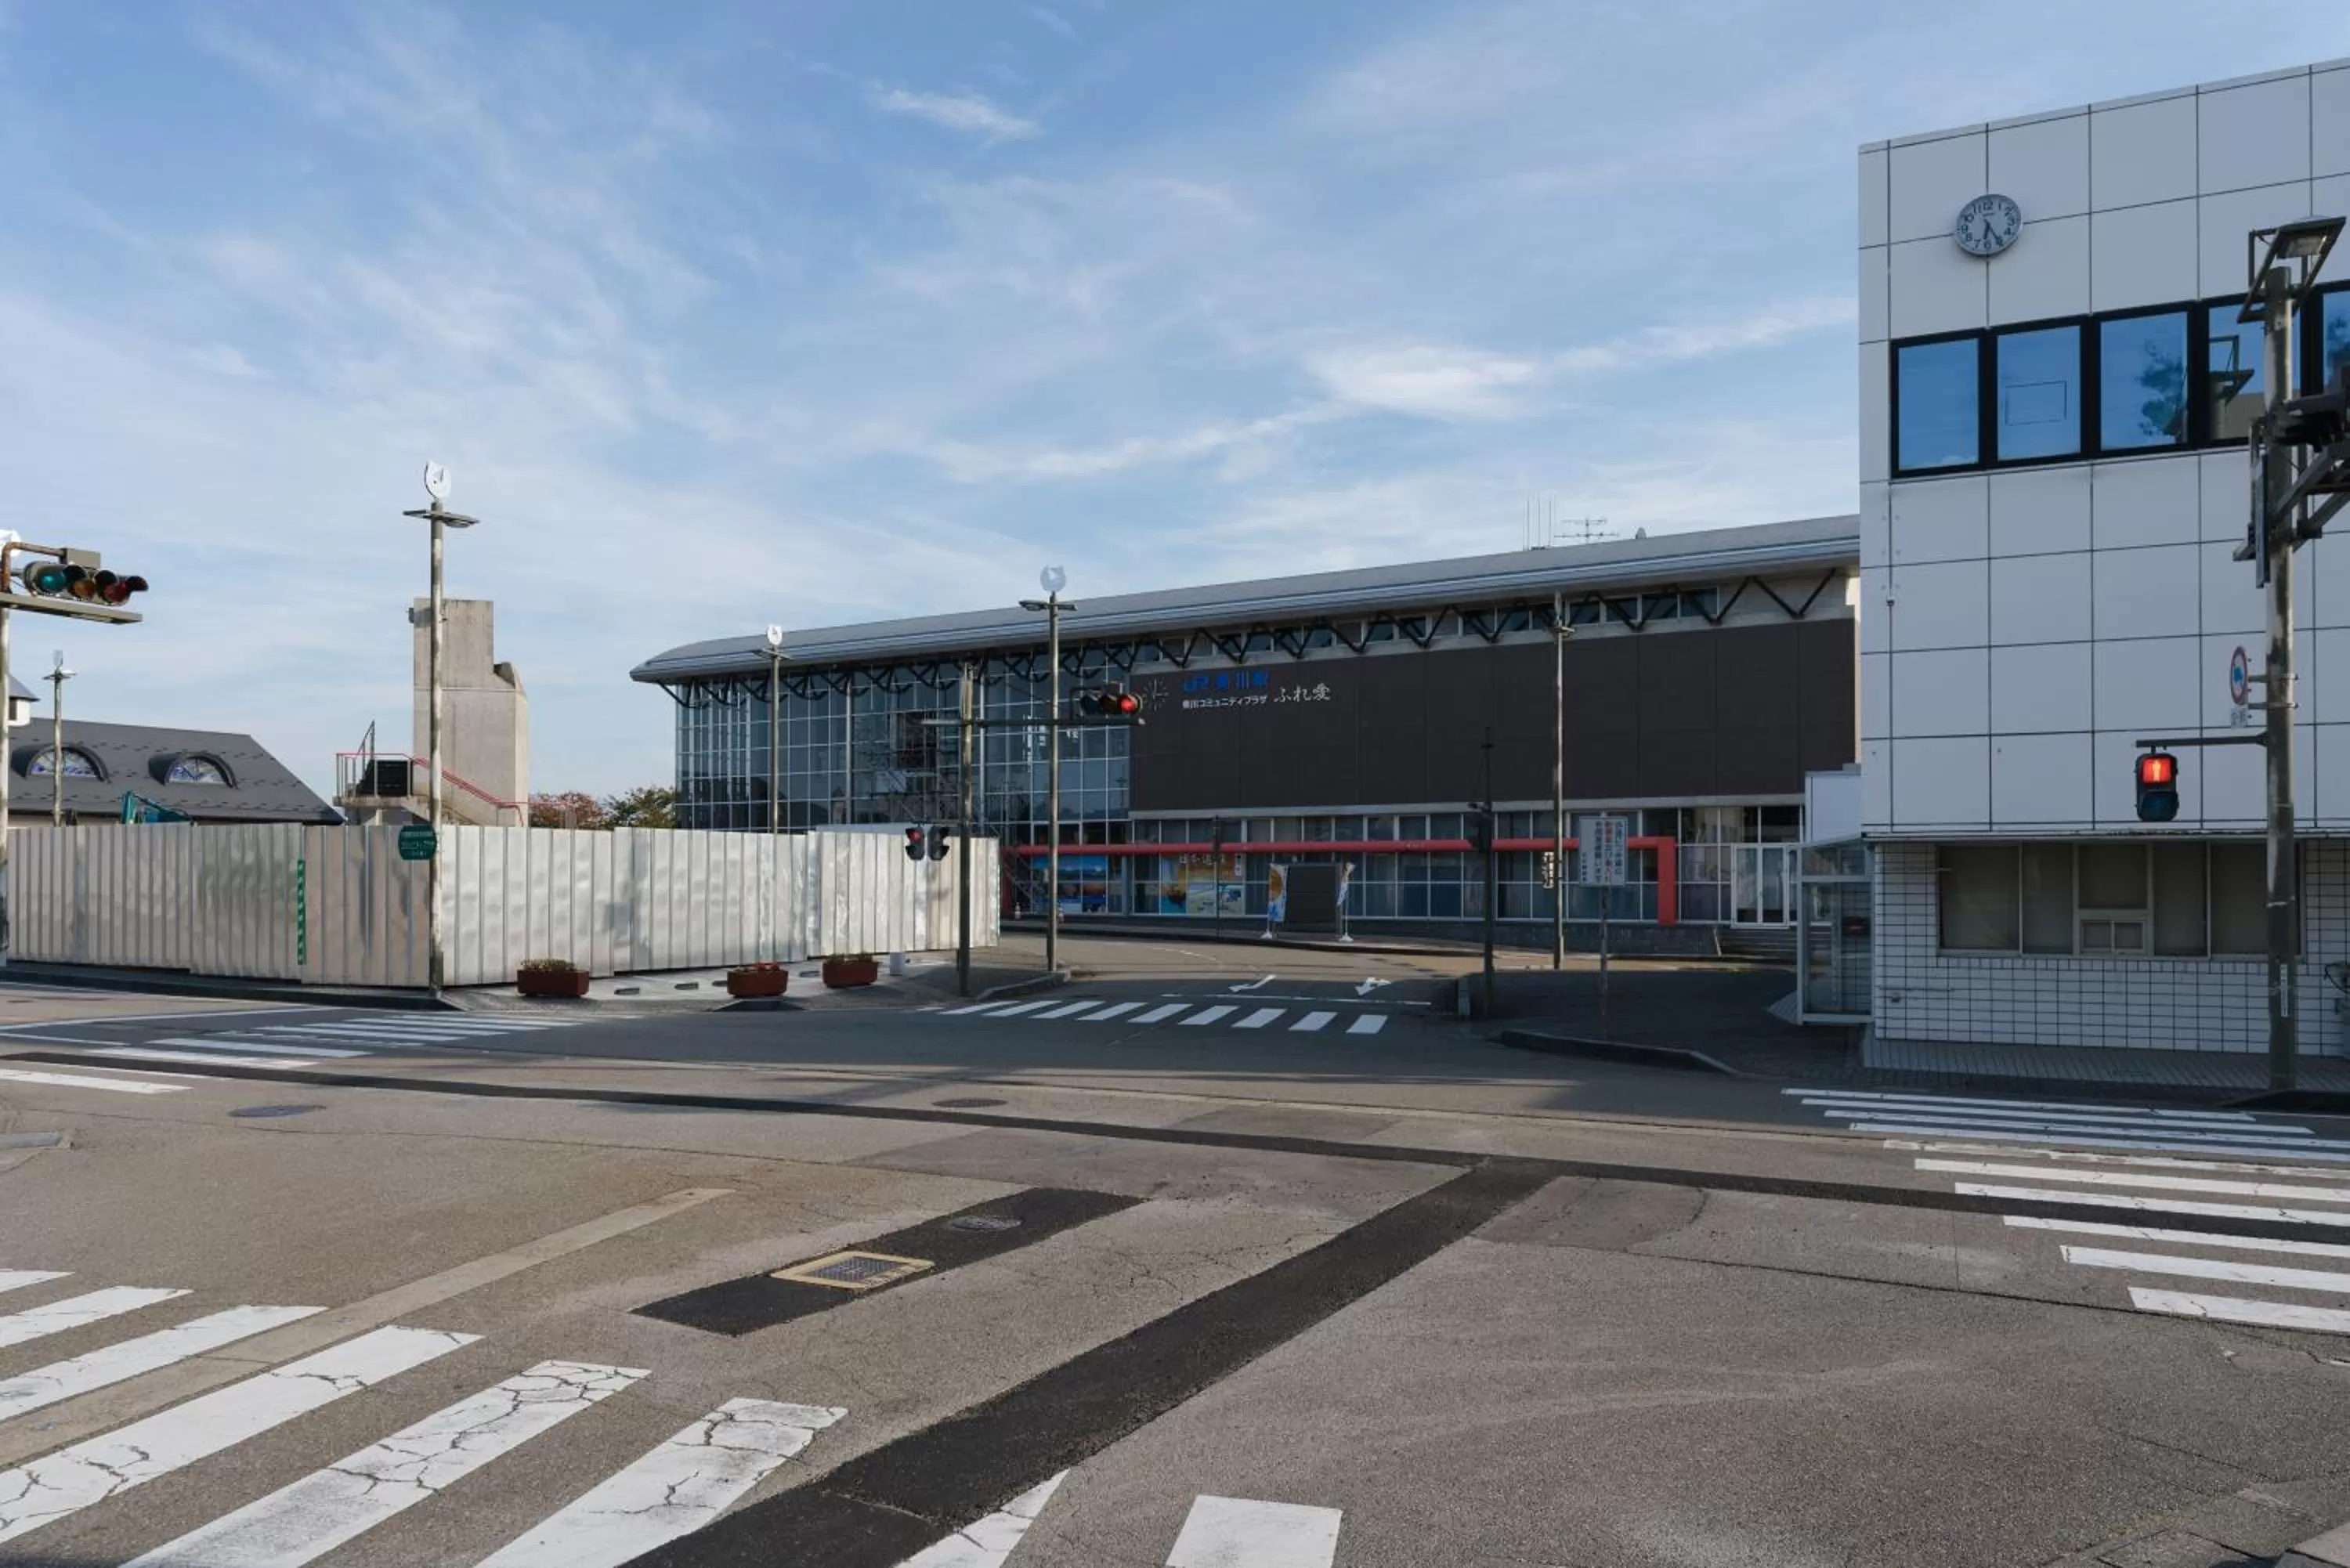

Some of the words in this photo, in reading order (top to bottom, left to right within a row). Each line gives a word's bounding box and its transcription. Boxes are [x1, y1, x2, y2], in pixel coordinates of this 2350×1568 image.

[1182, 695, 1268, 709] 川コミュニティプラザ
[1273, 682, 1332, 703] ふれ愛
